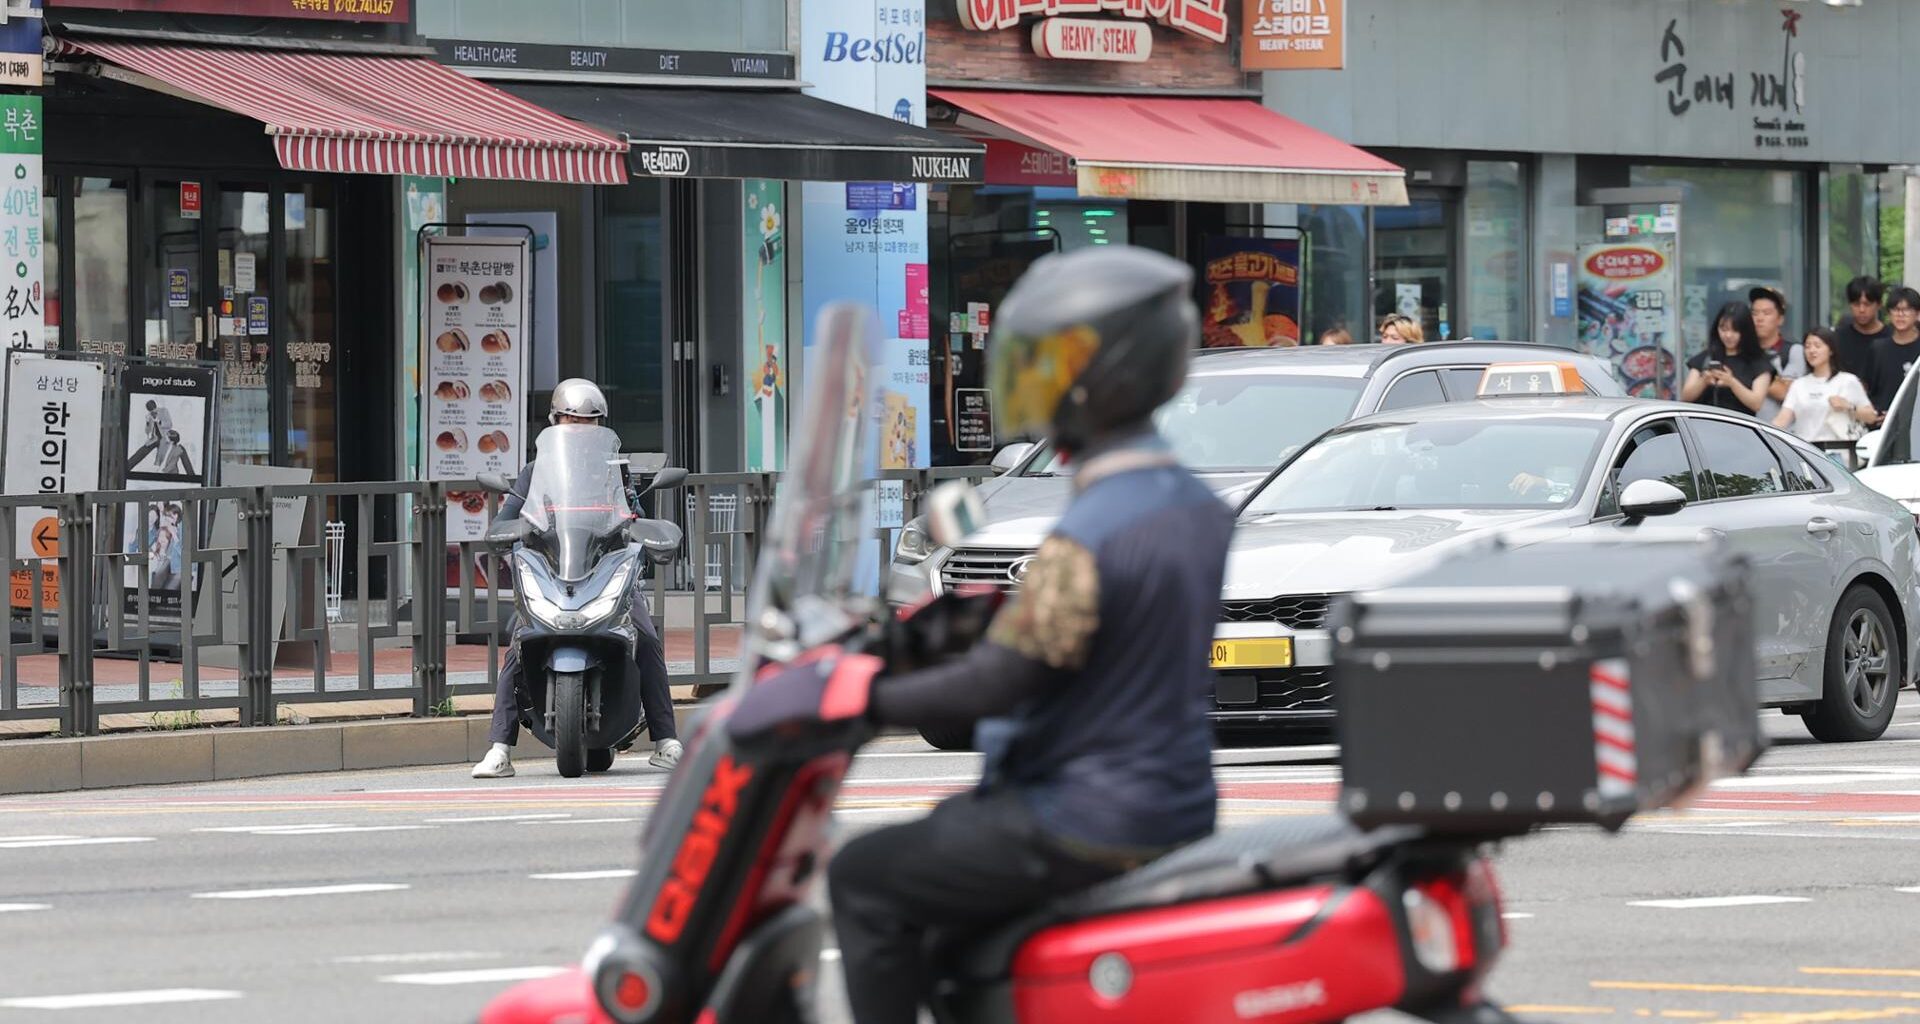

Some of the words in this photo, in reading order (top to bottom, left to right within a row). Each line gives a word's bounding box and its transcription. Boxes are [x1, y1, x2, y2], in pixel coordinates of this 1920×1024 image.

[1252, 15, 1331, 36] 스테이크
[1061, 25, 1095, 52] HEAVY
[1103, 27, 1137, 54] STEAK
[454, 46, 491, 62] HEALTH
[492, 48, 517, 63] CARE
[571, 51, 607, 66] BEAUTY
[660, 54, 680, 70] DIET
[731, 58, 768, 74] VITAMIN
[4, 107, 37, 141] 북촌
[641, 147, 684, 174] RE4DAY
[912, 156, 970, 178] NUKHAN
[1021, 152, 1064, 174] 스테이크
[3, 185, 39, 217] 40년
[844, 217, 882, 235] 올인원
[4, 226, 41, 258] 전통
[845, 241, 865, 254] 남자
[460, 261, 515, 277] 북촌단팥빵
[3, 285, 39, 321] 名人
[36, 376, 79, 393] 삼선당
[142, 377, 162, 387] page
[163, 377, 172, 386] of
[173, 378, 196, 387] studio
[1497, 374, 1541, 391] 서울
